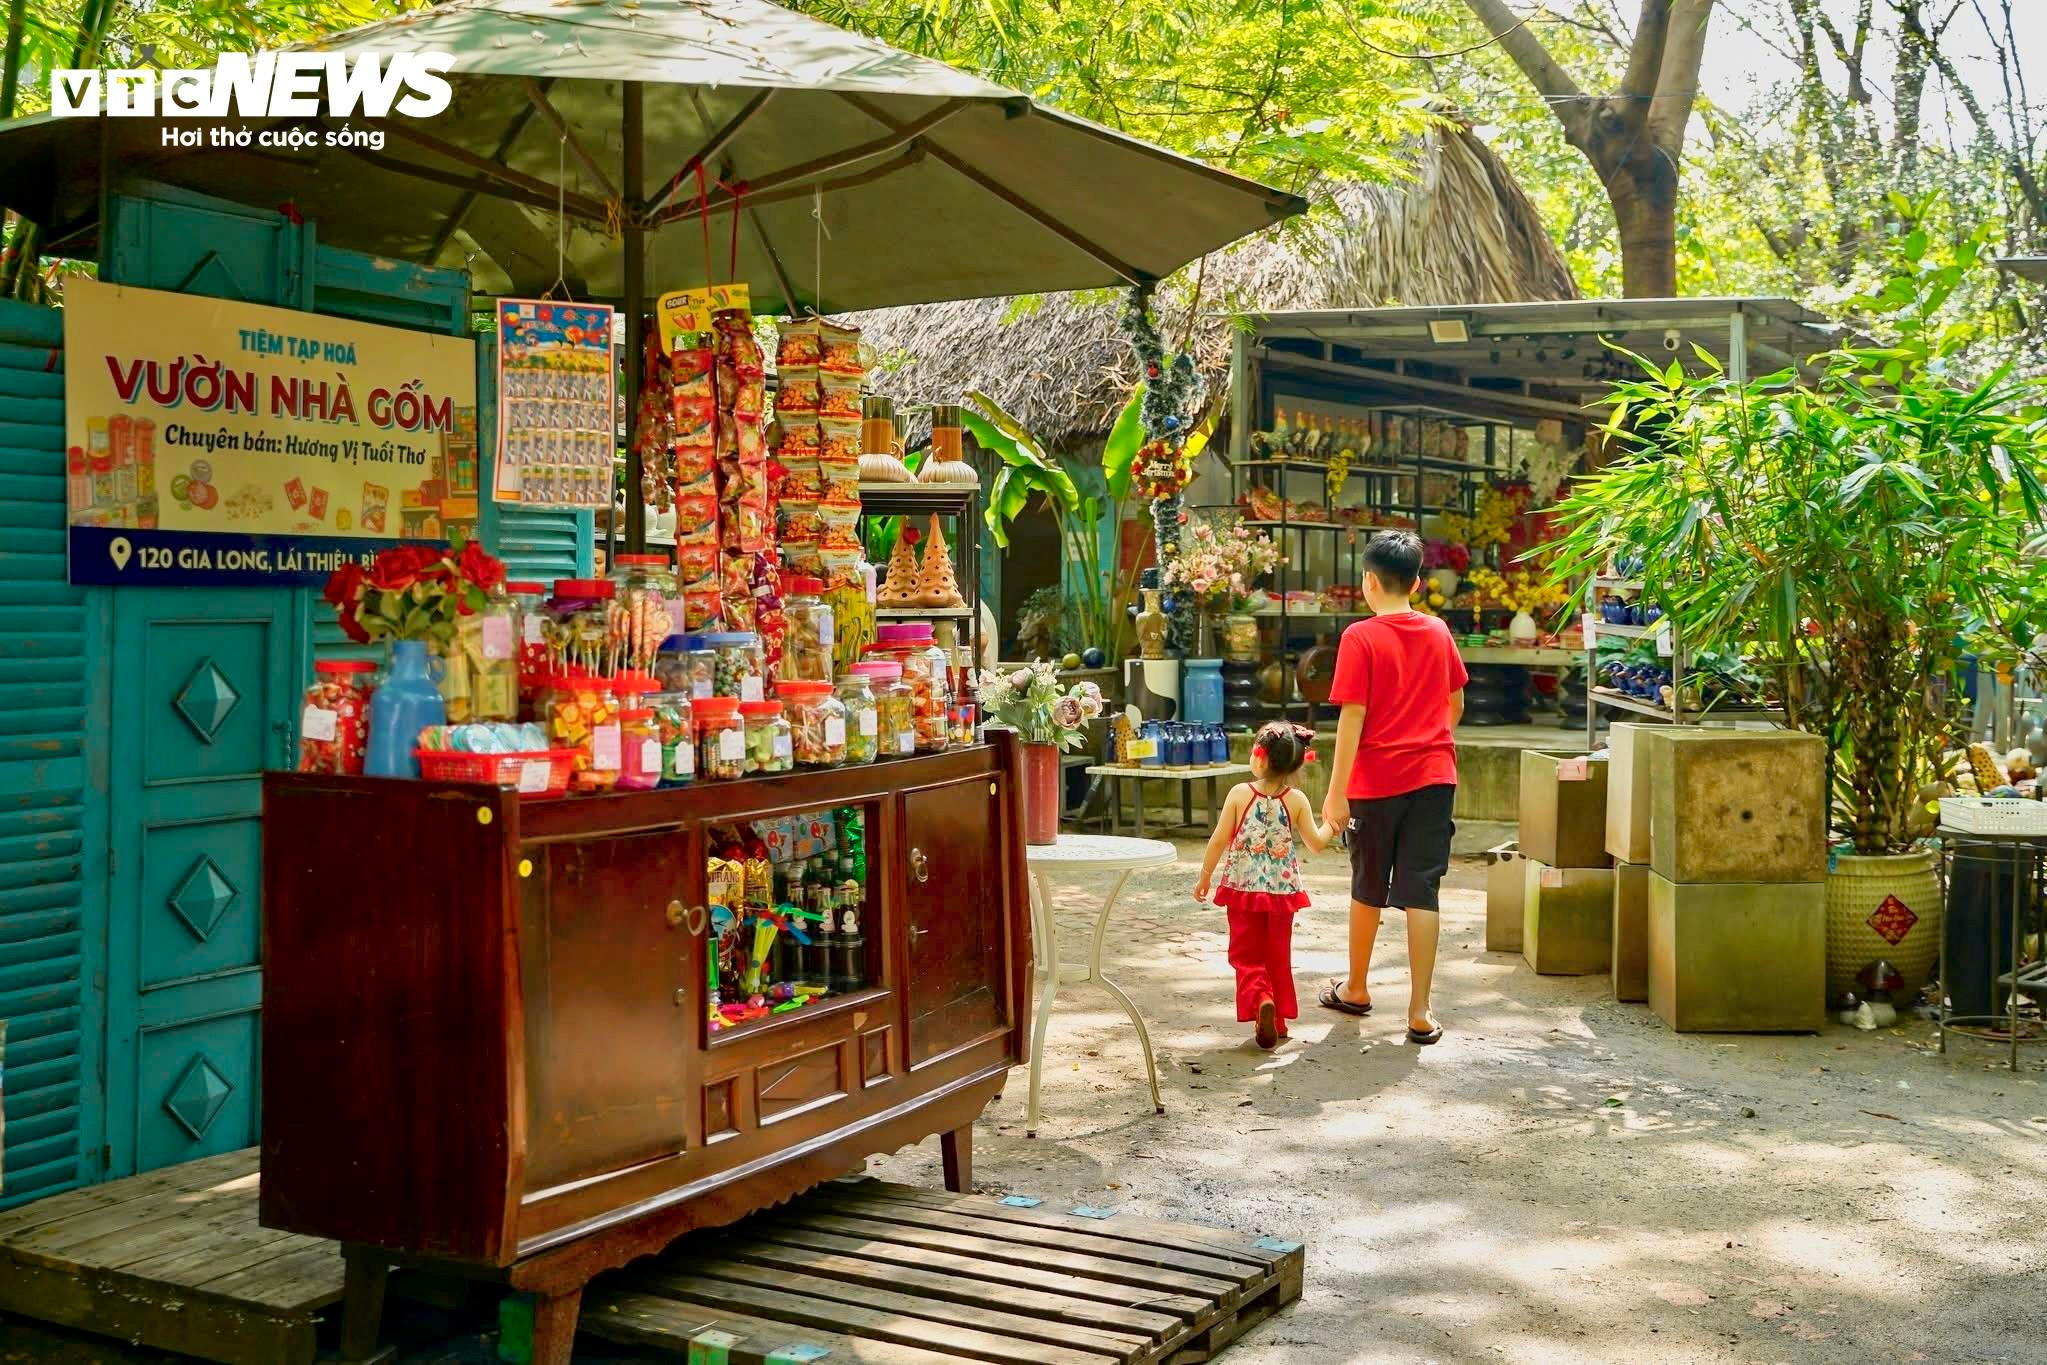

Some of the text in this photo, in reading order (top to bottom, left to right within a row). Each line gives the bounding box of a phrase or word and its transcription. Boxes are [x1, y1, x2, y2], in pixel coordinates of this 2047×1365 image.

[239, 328, 357, 366] TIỆM TẠP HOÁ
[105, 354, 455, 434] VƯỜN NHÀ GỐM
[165, 424, 427, 466] Chuyên bán: Hương Vị Tuổi Thơ
[138, 547, 174, 569] 120
[178, 549, 212, 570] GIA
[216, 550, 273, 573] LONG,
[277, 548, 302, 571] LÁI
